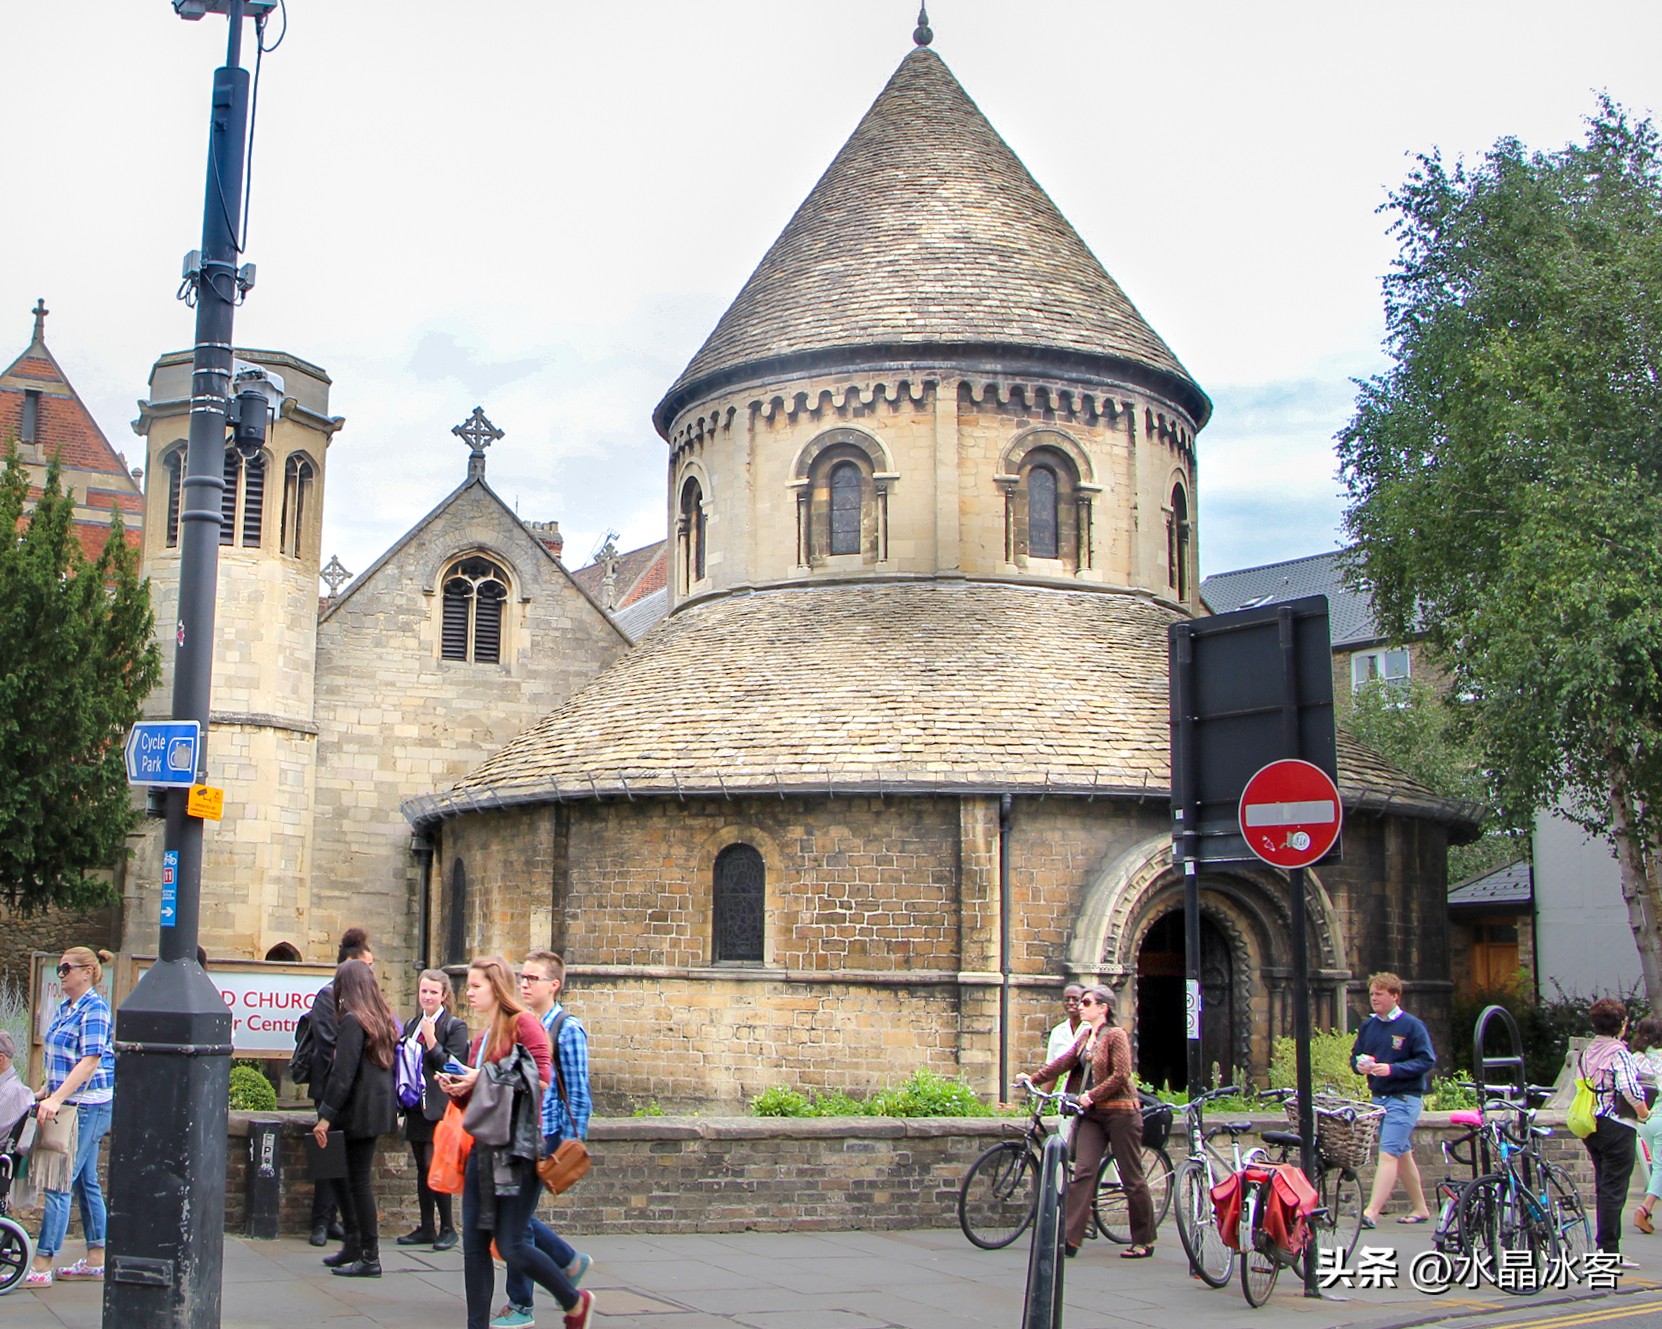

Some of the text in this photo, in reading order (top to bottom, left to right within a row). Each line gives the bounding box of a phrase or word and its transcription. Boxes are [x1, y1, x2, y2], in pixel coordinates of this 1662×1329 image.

[141, 732, 166, 753] Cycle
[141, 755, 162, 772] Park
[164, 870, 172, 881] 11
[243, 991, 318, 1010] CHURC
[247, 1015, 300, 1032] Centr
